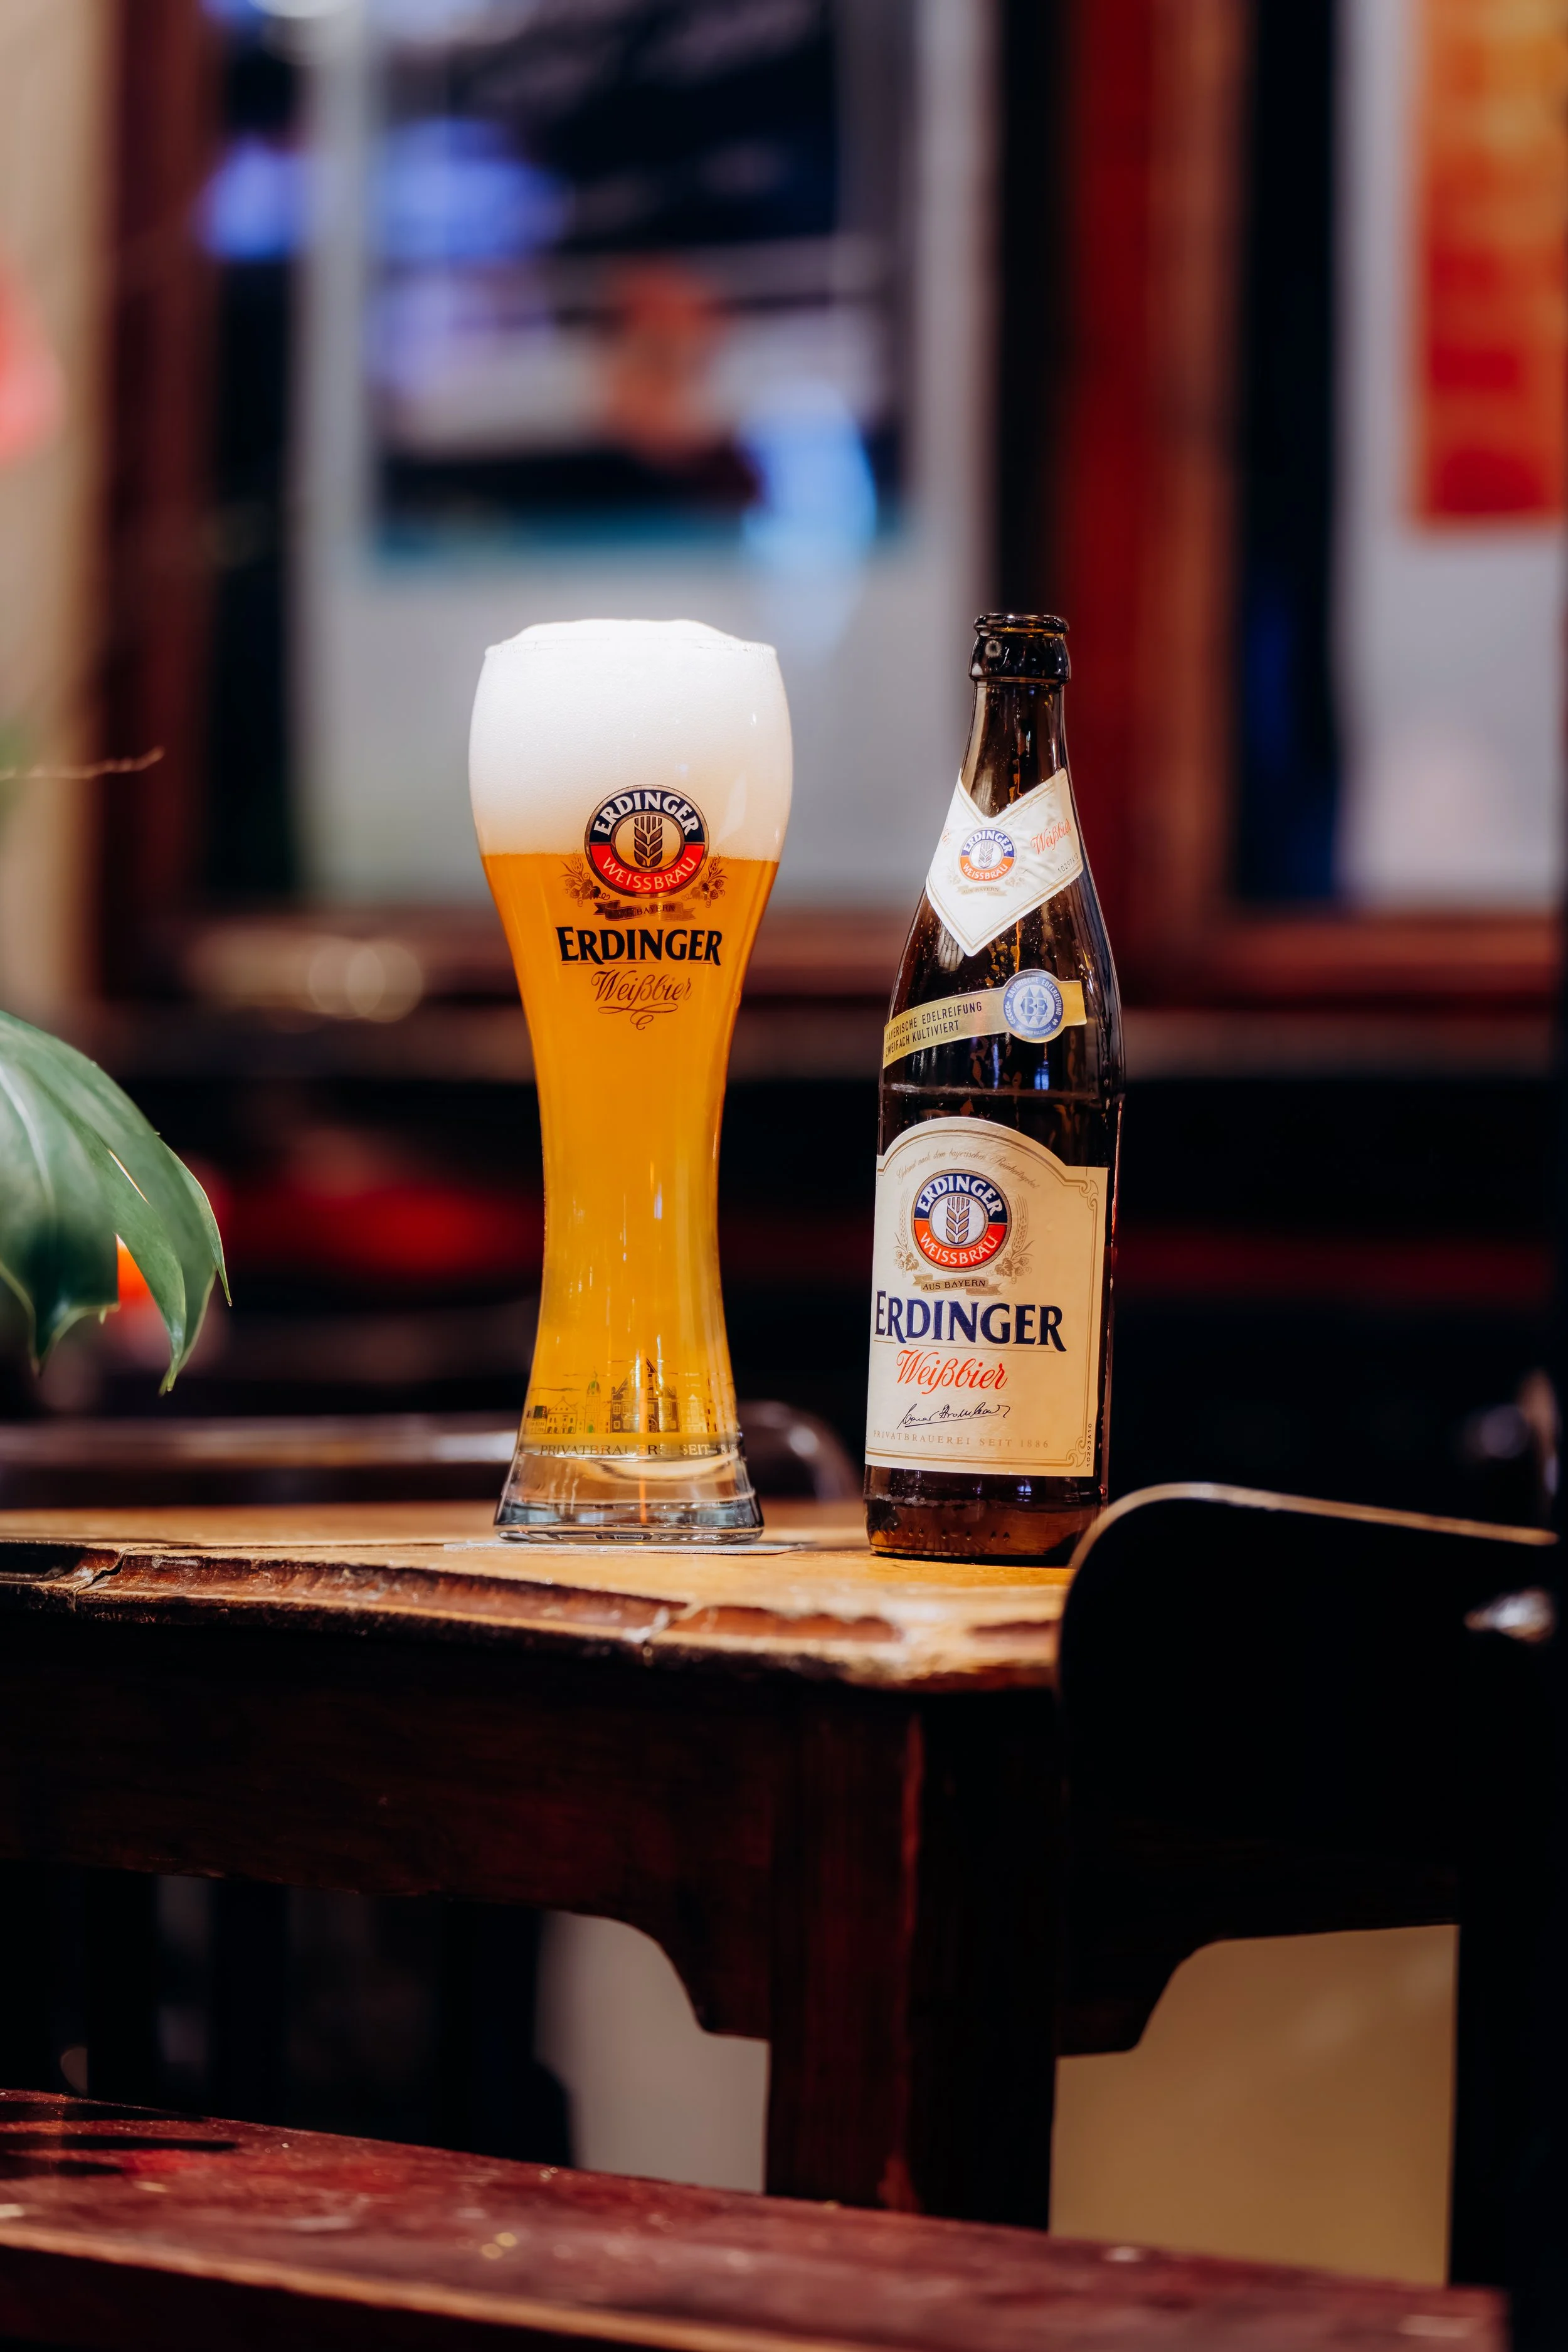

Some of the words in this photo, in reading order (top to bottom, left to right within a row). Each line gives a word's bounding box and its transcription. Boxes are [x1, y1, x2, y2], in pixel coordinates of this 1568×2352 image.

[593, 792, 699, 836] ERDINGER
[963, 830, 1012, 854] ERDINGER
[603, 857, 696, 891] WEISSBRÄU
[963, 862, 1009, 879] WEISSBRÄU
[637, 904, 675, 916] BAYERN
[555, 926, 723, 966] ERDINGER
[591, 968, 692, 1016] Weißbier
[1007, 977, 1039, 999] BAYERISCHE
[1041, 979, 1062, 1016] EDELREIFUNG
[922, 1002, 982, 1024] EDELREIFUNG
[886, 1034, 910, 1057] ZWEIFACH
[913, 1020, 959, 1042] KULTIVIERT
[918, 1175, 1003, 1216] ERDINGER
[920, 1232, 998, 1264] WEISSBRÄU
[945, 1279, 985, 1288] BAYERN
[874, 1290, 1066, 1352] ERDINGER
[896, 1350, 1008, 1394] Weißbier
[679, 1444, 710, 1455] SEIT
[873, 1429, 970, 1445] PRIVATBRAUEREI
[979, 1438, 1012, 1447] SEIT
[1020, 1439, 1049, 1448] 1886
